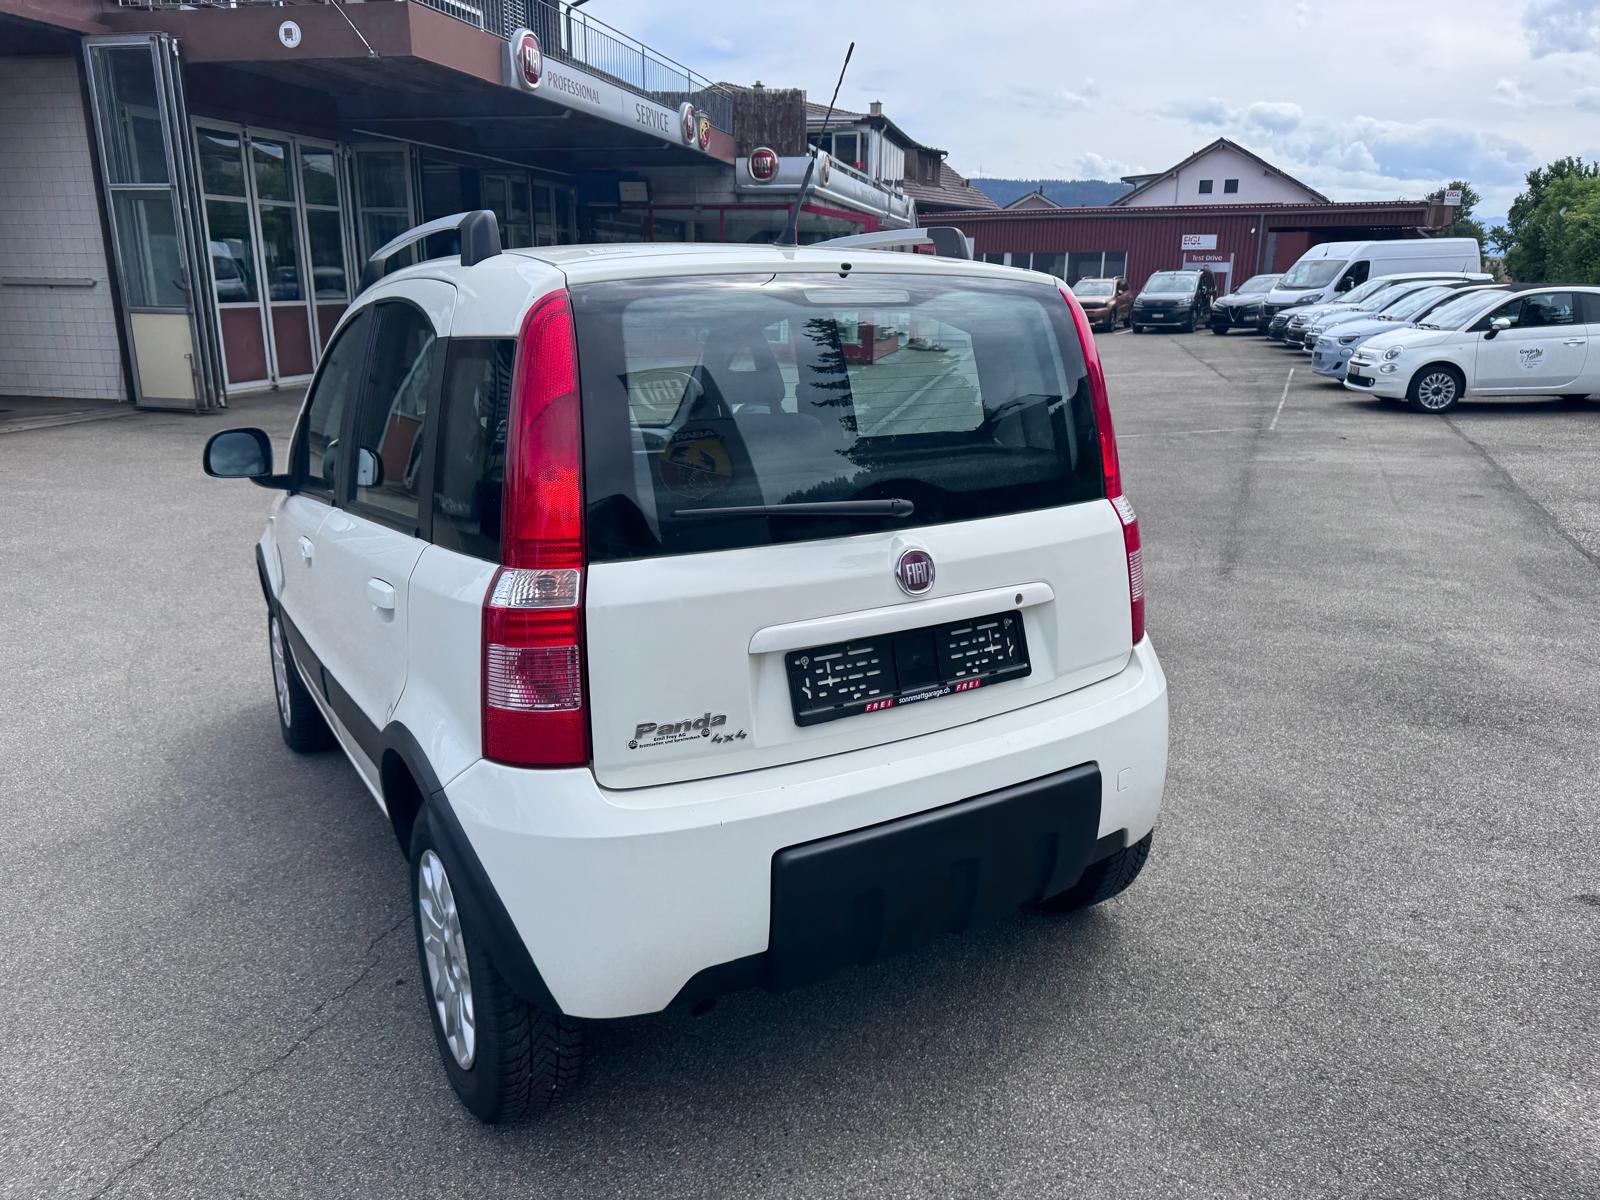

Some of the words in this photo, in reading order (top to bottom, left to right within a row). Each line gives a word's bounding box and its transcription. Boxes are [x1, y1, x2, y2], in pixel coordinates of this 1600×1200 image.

[525, 46, 541, 72] FIAT
[547, 71, 601, 104] PROFESSIONAL
[635, 103, 669, 132] SERVICE
[754, 157, 772, 168] FIAT
[906, 561, 928, 585] FIAT
[866, 700, 893, 711] FREI
[899, 687, 951, 704] sonnmattgarage.ch
[957, 680, 980, 691] FREI
[634, 712, 727, 740] Panda
[711, 729, 748, 743] 4x4
